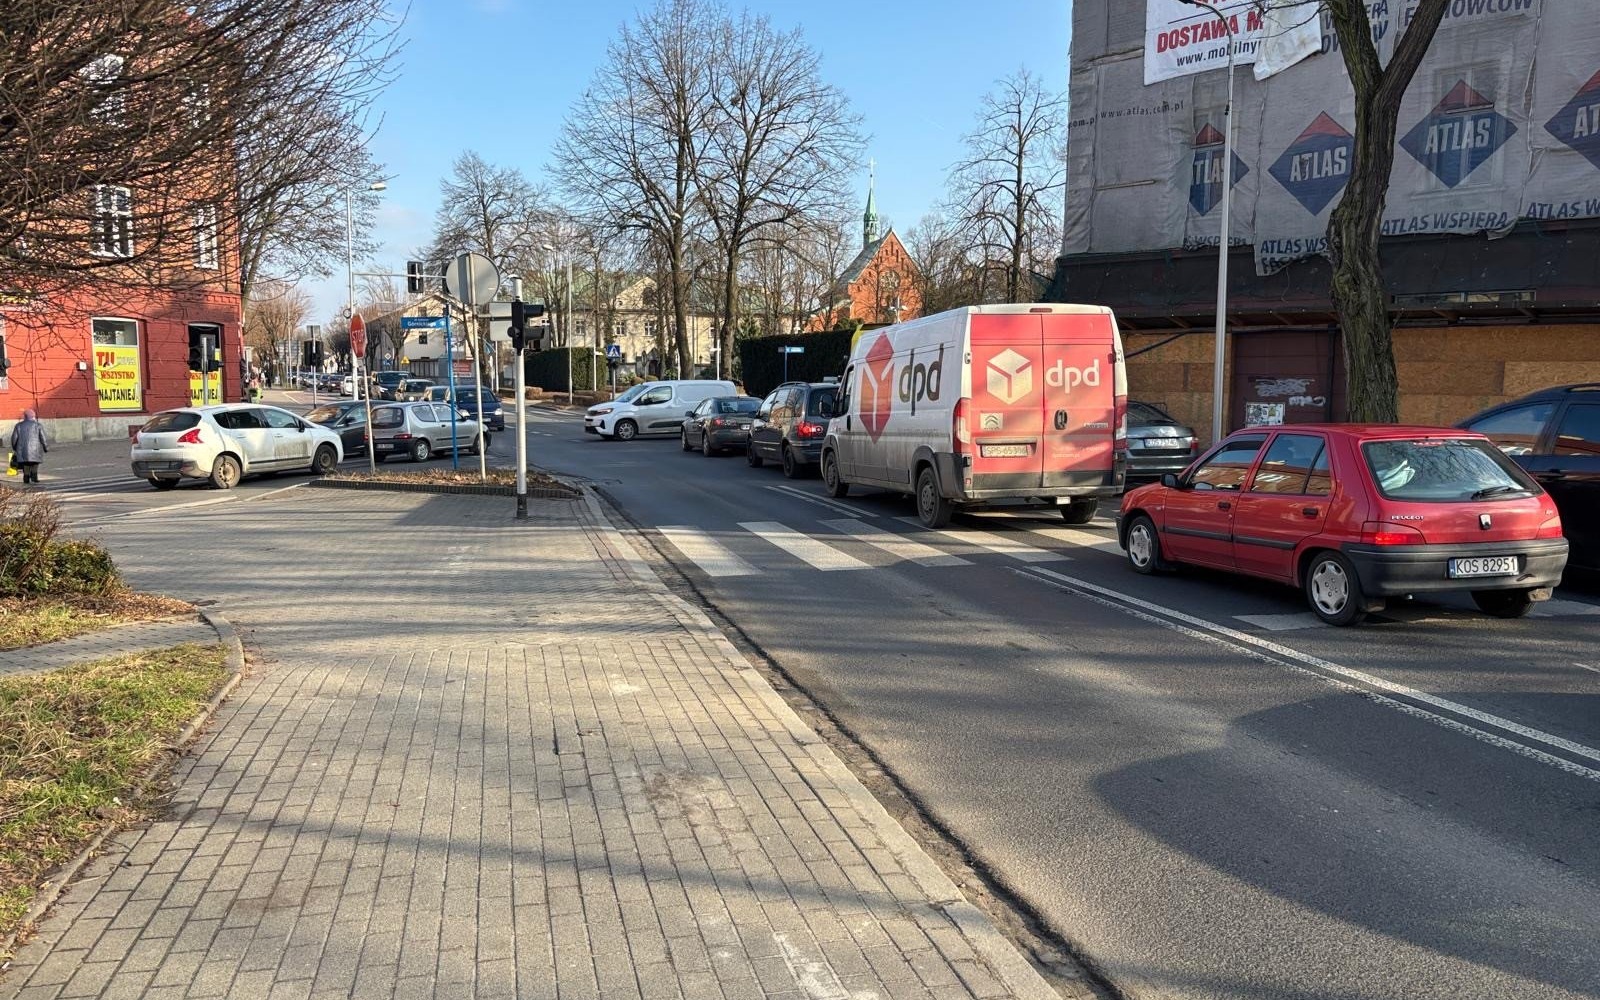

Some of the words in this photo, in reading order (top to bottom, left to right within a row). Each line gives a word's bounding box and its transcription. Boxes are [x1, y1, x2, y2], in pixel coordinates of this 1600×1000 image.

[1157, 15, 1240, 53] DOSTAWA
[1425, 118, 1491, 154] ATLAS
[1290, 147, 1347, 182] ATLAS
[1381, 214, 1430, 235] ATLAS
[1433, 211, 1510, 230] WSPIERA
[1525, 202, 1582, 220] ATLAS
[1261, 239, 1301, 254] ATLAS
[351, 329, 365, 343] STOP
[100, 370, 136, 380] WSZYSTKO
[898, 343, 944, 416] dpd
[1046, 359, 1099, 394] dpd
[1455, 558, 1479, 574] KOS
[1482, 555, 1517, 572] 82951
